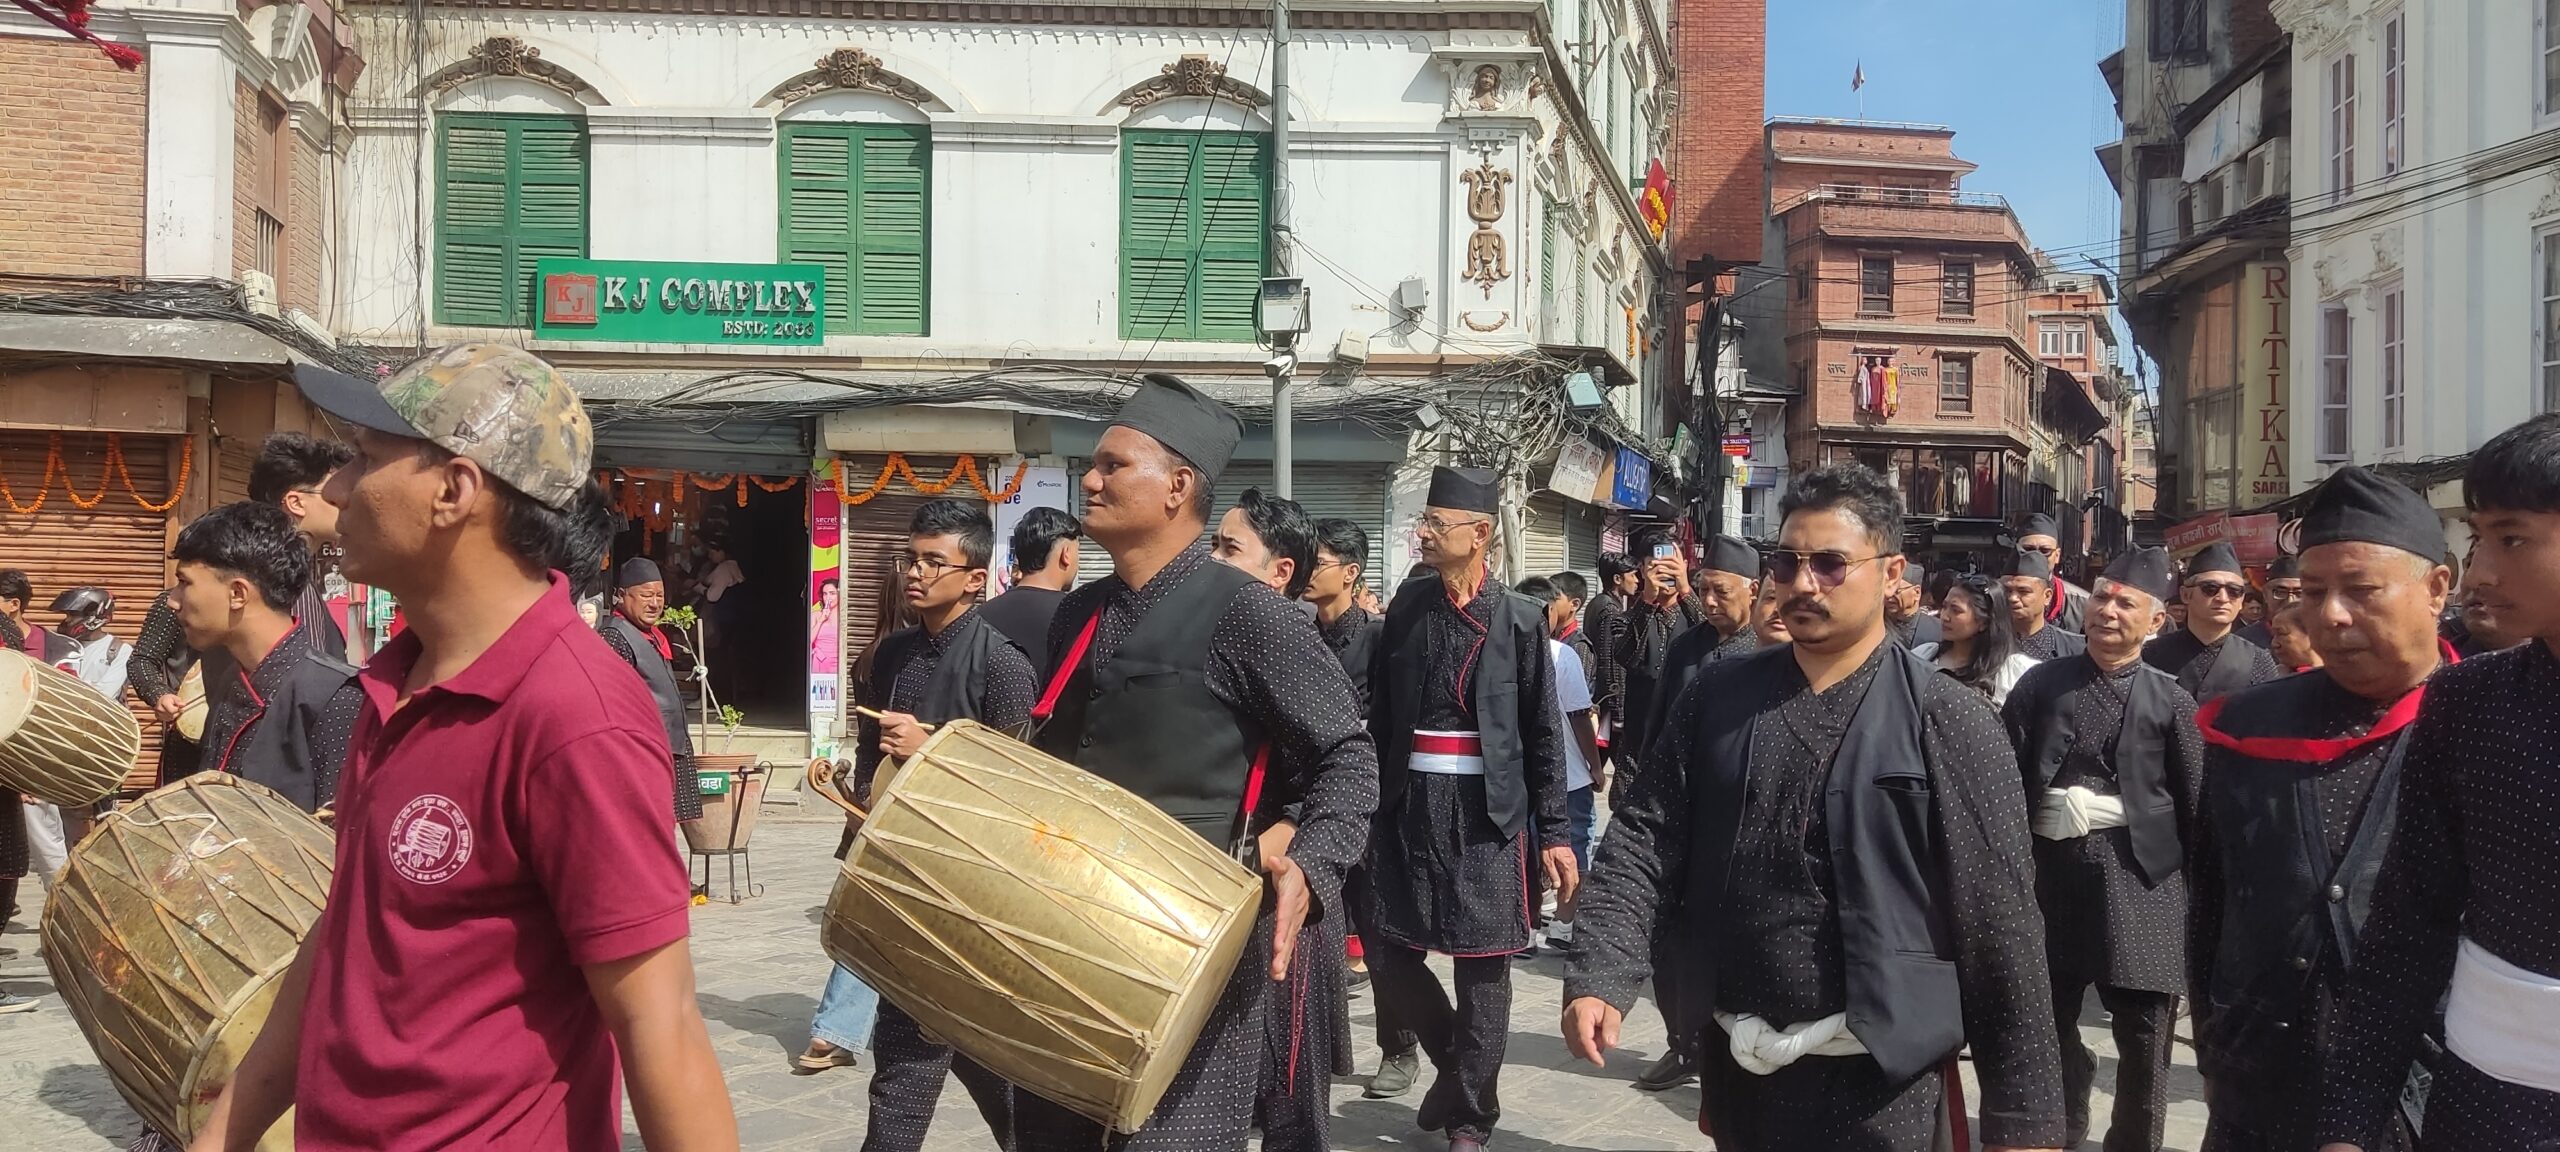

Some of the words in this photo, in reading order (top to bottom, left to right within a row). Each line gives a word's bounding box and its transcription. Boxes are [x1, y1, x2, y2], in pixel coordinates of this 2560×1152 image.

[603, 276, 651, 310] KJ
[661, 278, 817, 312] COMPLEX
[723, 320, 769, 335] ESTD:
[2259, 267, 2289, 477] RITIKA
[815, 515, 838, 524] secret
